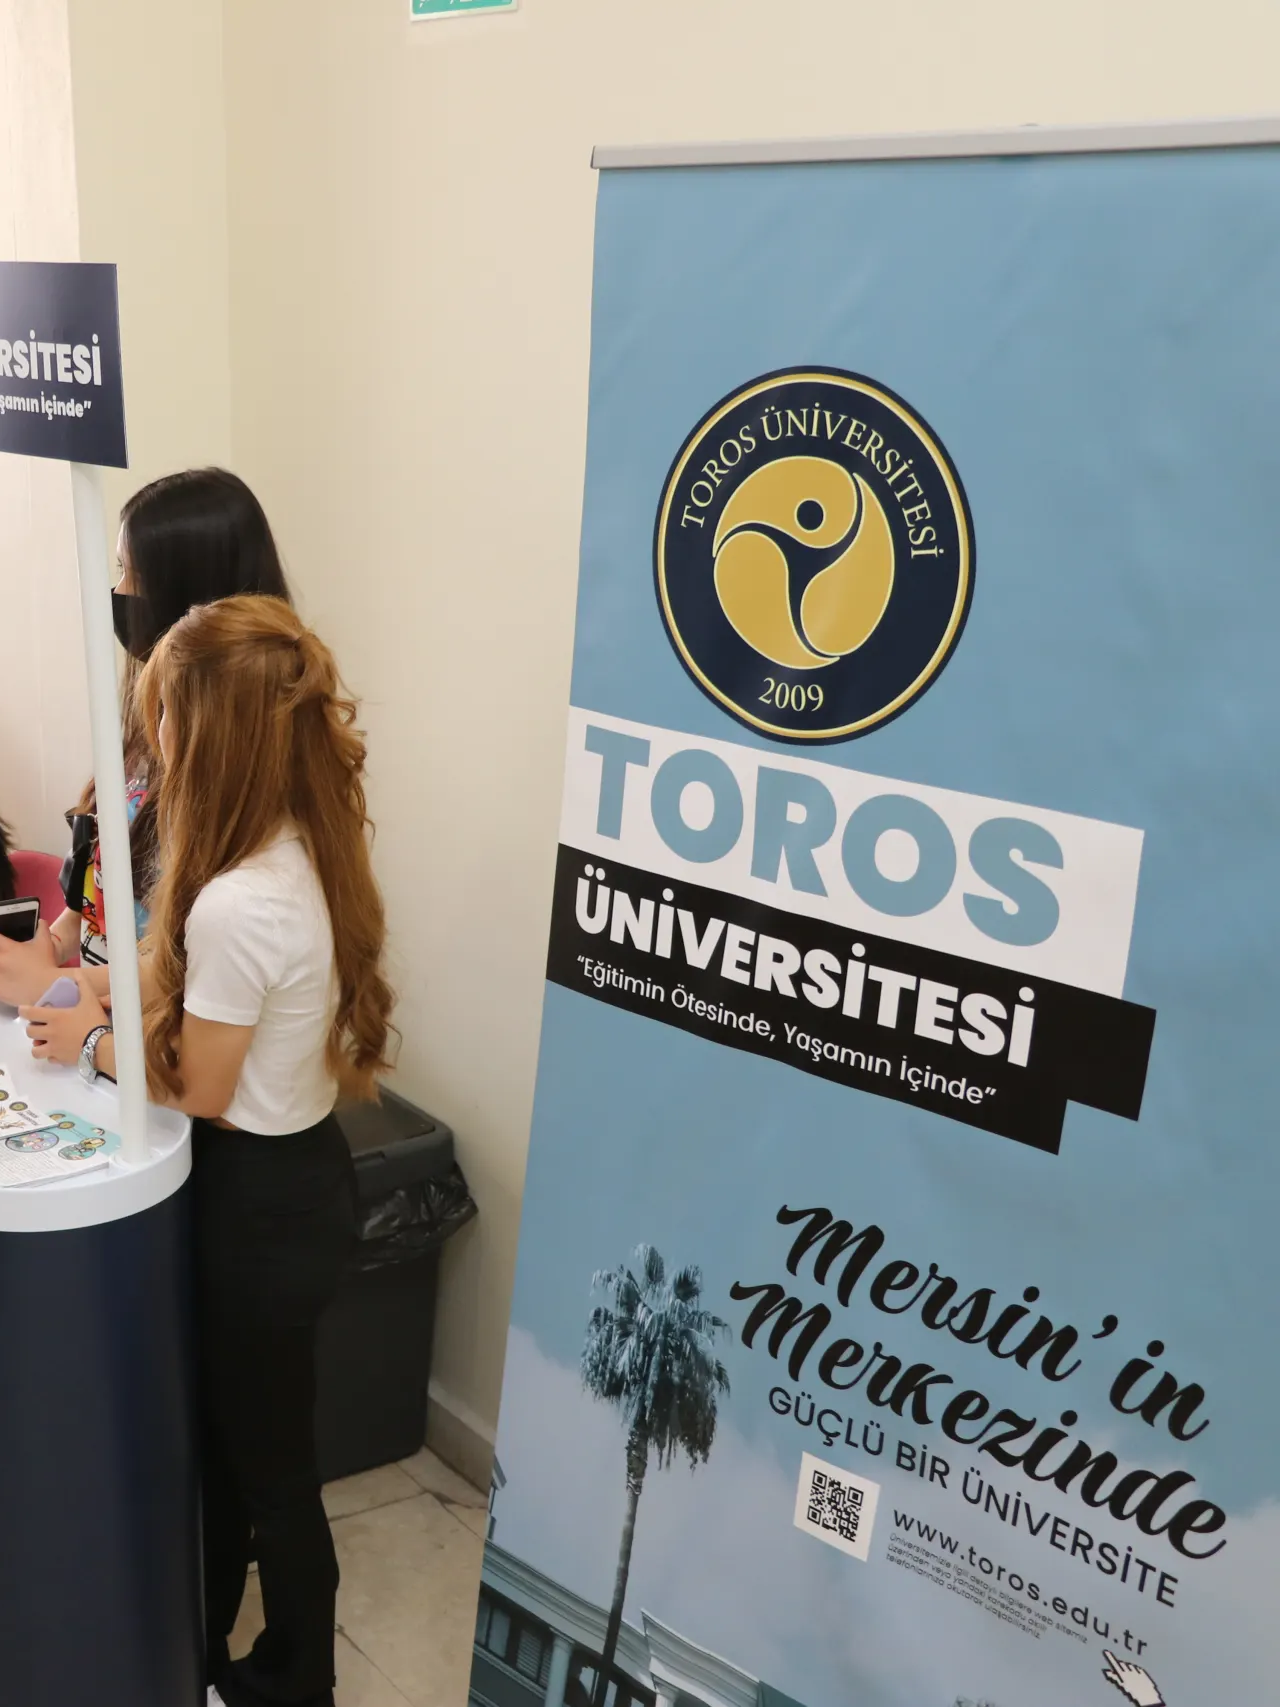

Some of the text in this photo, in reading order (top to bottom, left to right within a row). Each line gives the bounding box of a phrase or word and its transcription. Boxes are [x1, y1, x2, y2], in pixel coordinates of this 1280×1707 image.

[680, 402, 945, 559] TOROS ÜNİVERSİTESİ
[758, 676, 824, 712] 2009
[584, 724, 1064, 947] TOROS
[575, 864, 1036, 1067] ÜNİVERSİTESİ
[671, 983, 776, 1042] Ötesinde,
[783, 1022, 892, 1077] Yaşamın
[729, 1281, 1228, 1559] Merkezinde
[769, 1386, 1179, 1608] GÜÇLÜ BİR ÜNİVERSİTE
[893, 1509, 1148, 1656] www.toros.edu.tr
